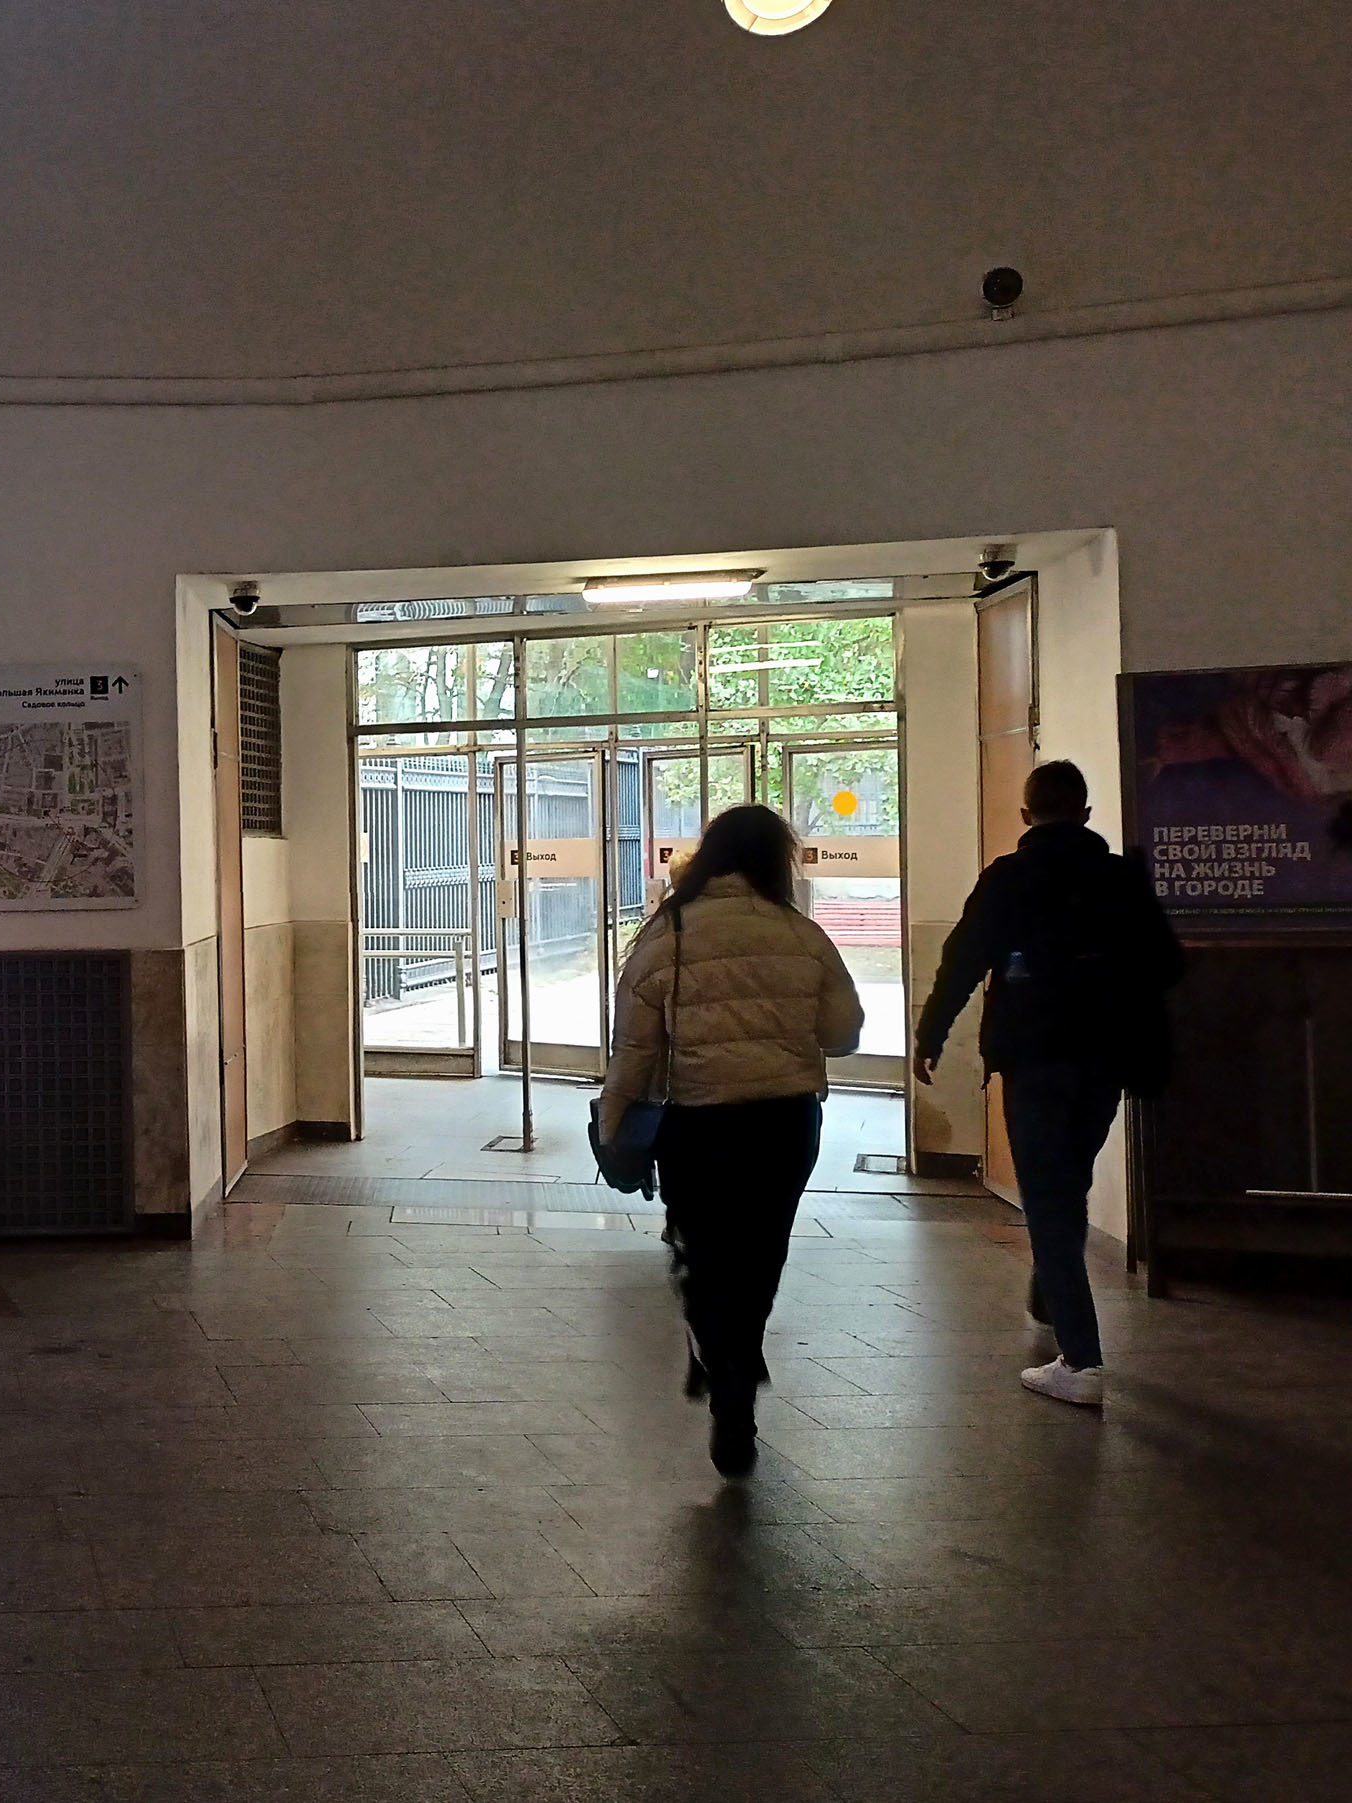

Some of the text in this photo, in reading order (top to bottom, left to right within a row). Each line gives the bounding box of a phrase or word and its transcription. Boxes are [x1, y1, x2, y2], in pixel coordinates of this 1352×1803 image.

[55, 678, 84, 688] улица
[35, 687, 85, 696] Якиманка
[22, 701, 56, 709] Садовое
[1153, 823, 1287, 842] ПЕРЕВЕРНИ
[821, 850, 858, 861] Выход
[1153, 841, 1312, 861] СВОЙ ВЗГЛЯД
[526, 852, 557, 862] Выход
[1154, 861, 1277, 878] НА ЖИЗНЬ
[1155, 880, 1265, 899] В ГОРОДЕ
